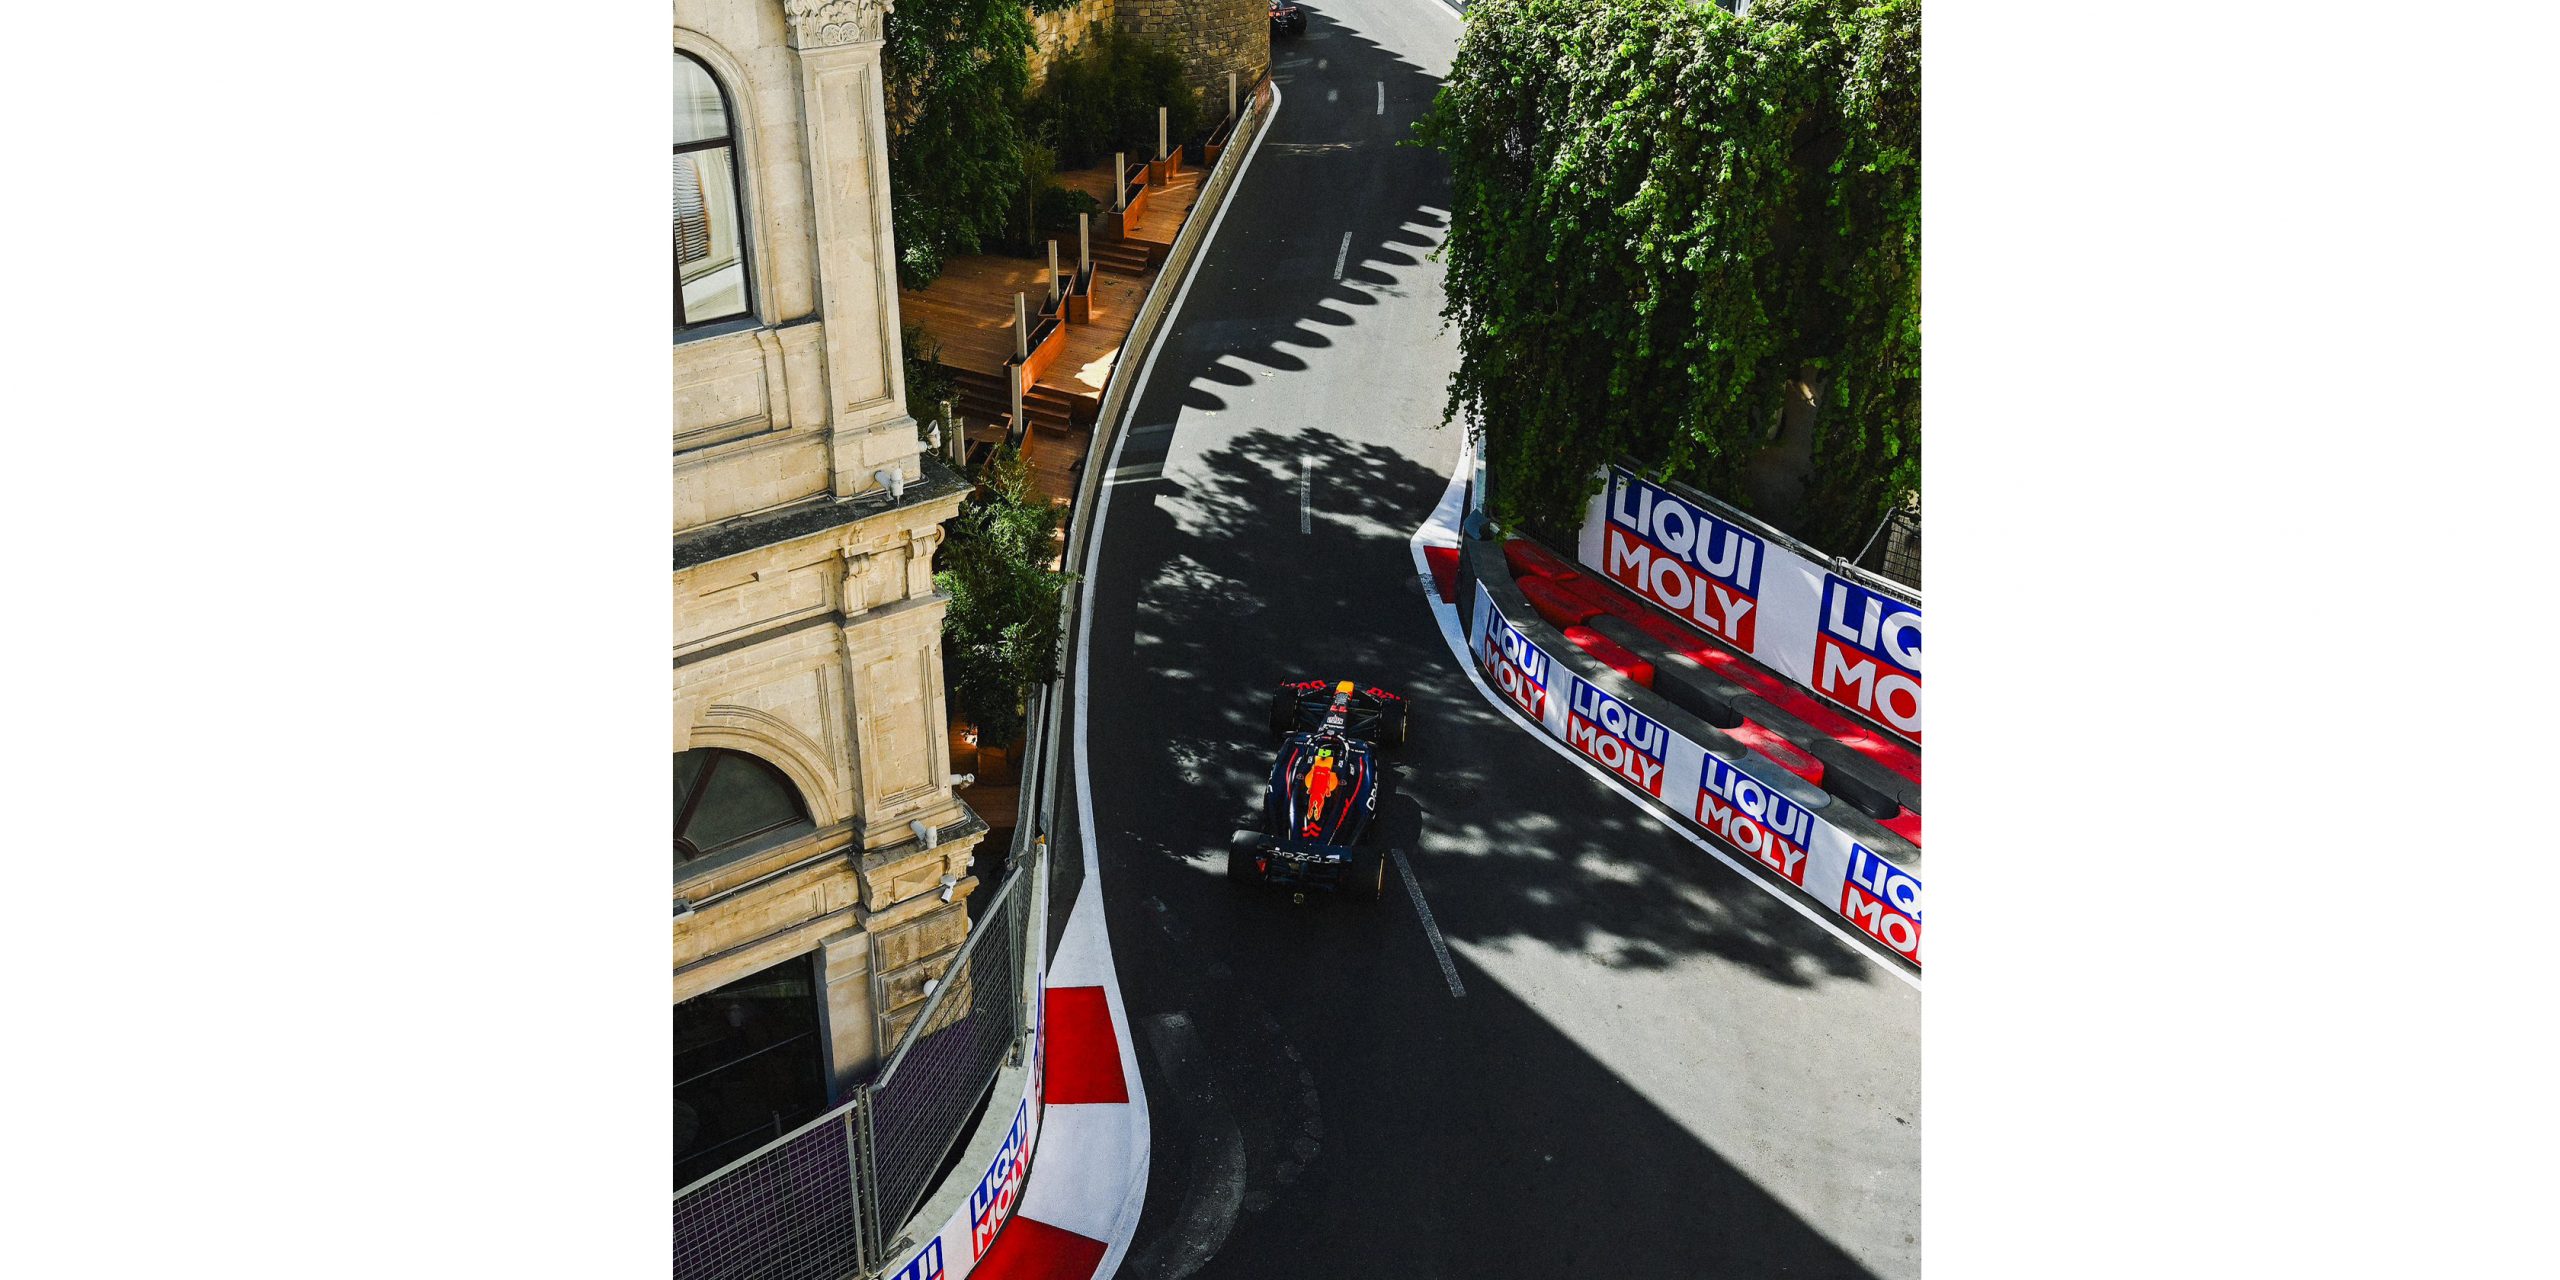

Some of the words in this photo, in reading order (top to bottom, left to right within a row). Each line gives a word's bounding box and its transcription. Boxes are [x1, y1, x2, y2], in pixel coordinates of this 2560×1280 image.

[1614, 475, 1755, 590] LIQUI
[1610, 530, 1754, 641] MOLY
[1486, 641, 1545, 714] MOLY
[1488, 607, 1547, 686] LIQUI
[1571, 715, 1662, 788] MOLY
[1573, 681, 1664, 759] LIQUI
[1701, 793, 1805, 878] MOLY
[1705, 758, 1809, 846] LIQUI
[1852, 849, 1921, 921] LIQ
[973, 1103, 1027, 1224] LIQUI
[977, 1135, 1028, 1256] MOLY
